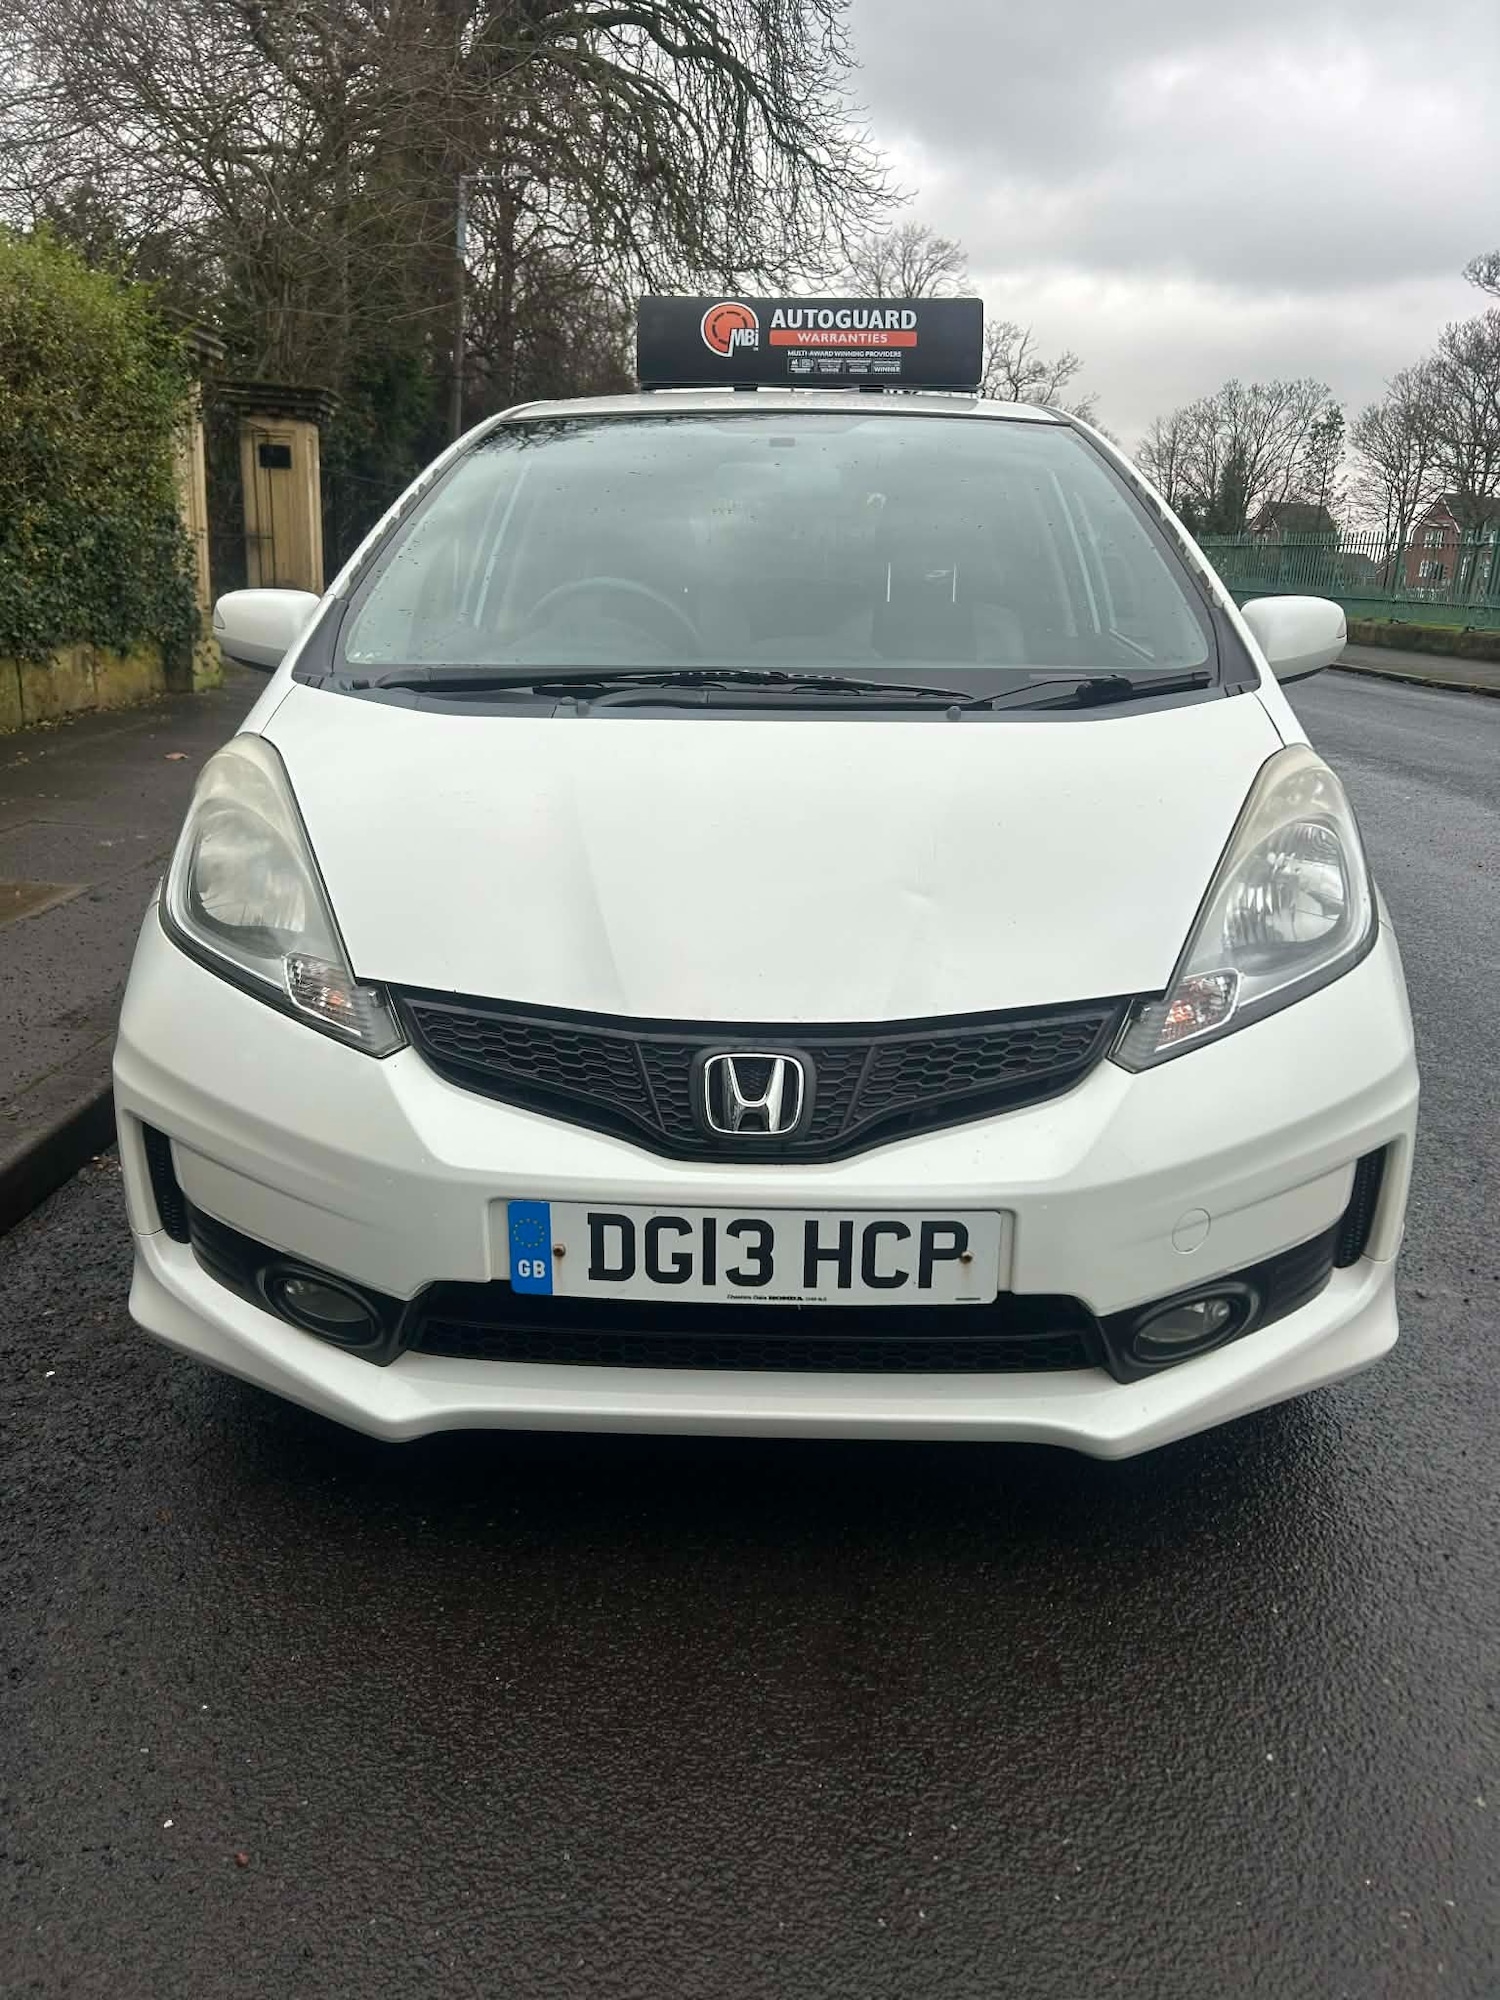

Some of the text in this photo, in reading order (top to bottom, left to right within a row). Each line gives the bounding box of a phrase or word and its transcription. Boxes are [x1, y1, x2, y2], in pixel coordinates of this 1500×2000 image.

[770, 309, 917, 329] AUTOGUARD
[797, 333, 888, 344] WARRANTIES
[587, 1212, 970, 1290] DG13 HCP
[517, 1259, 546, 1279] GB
